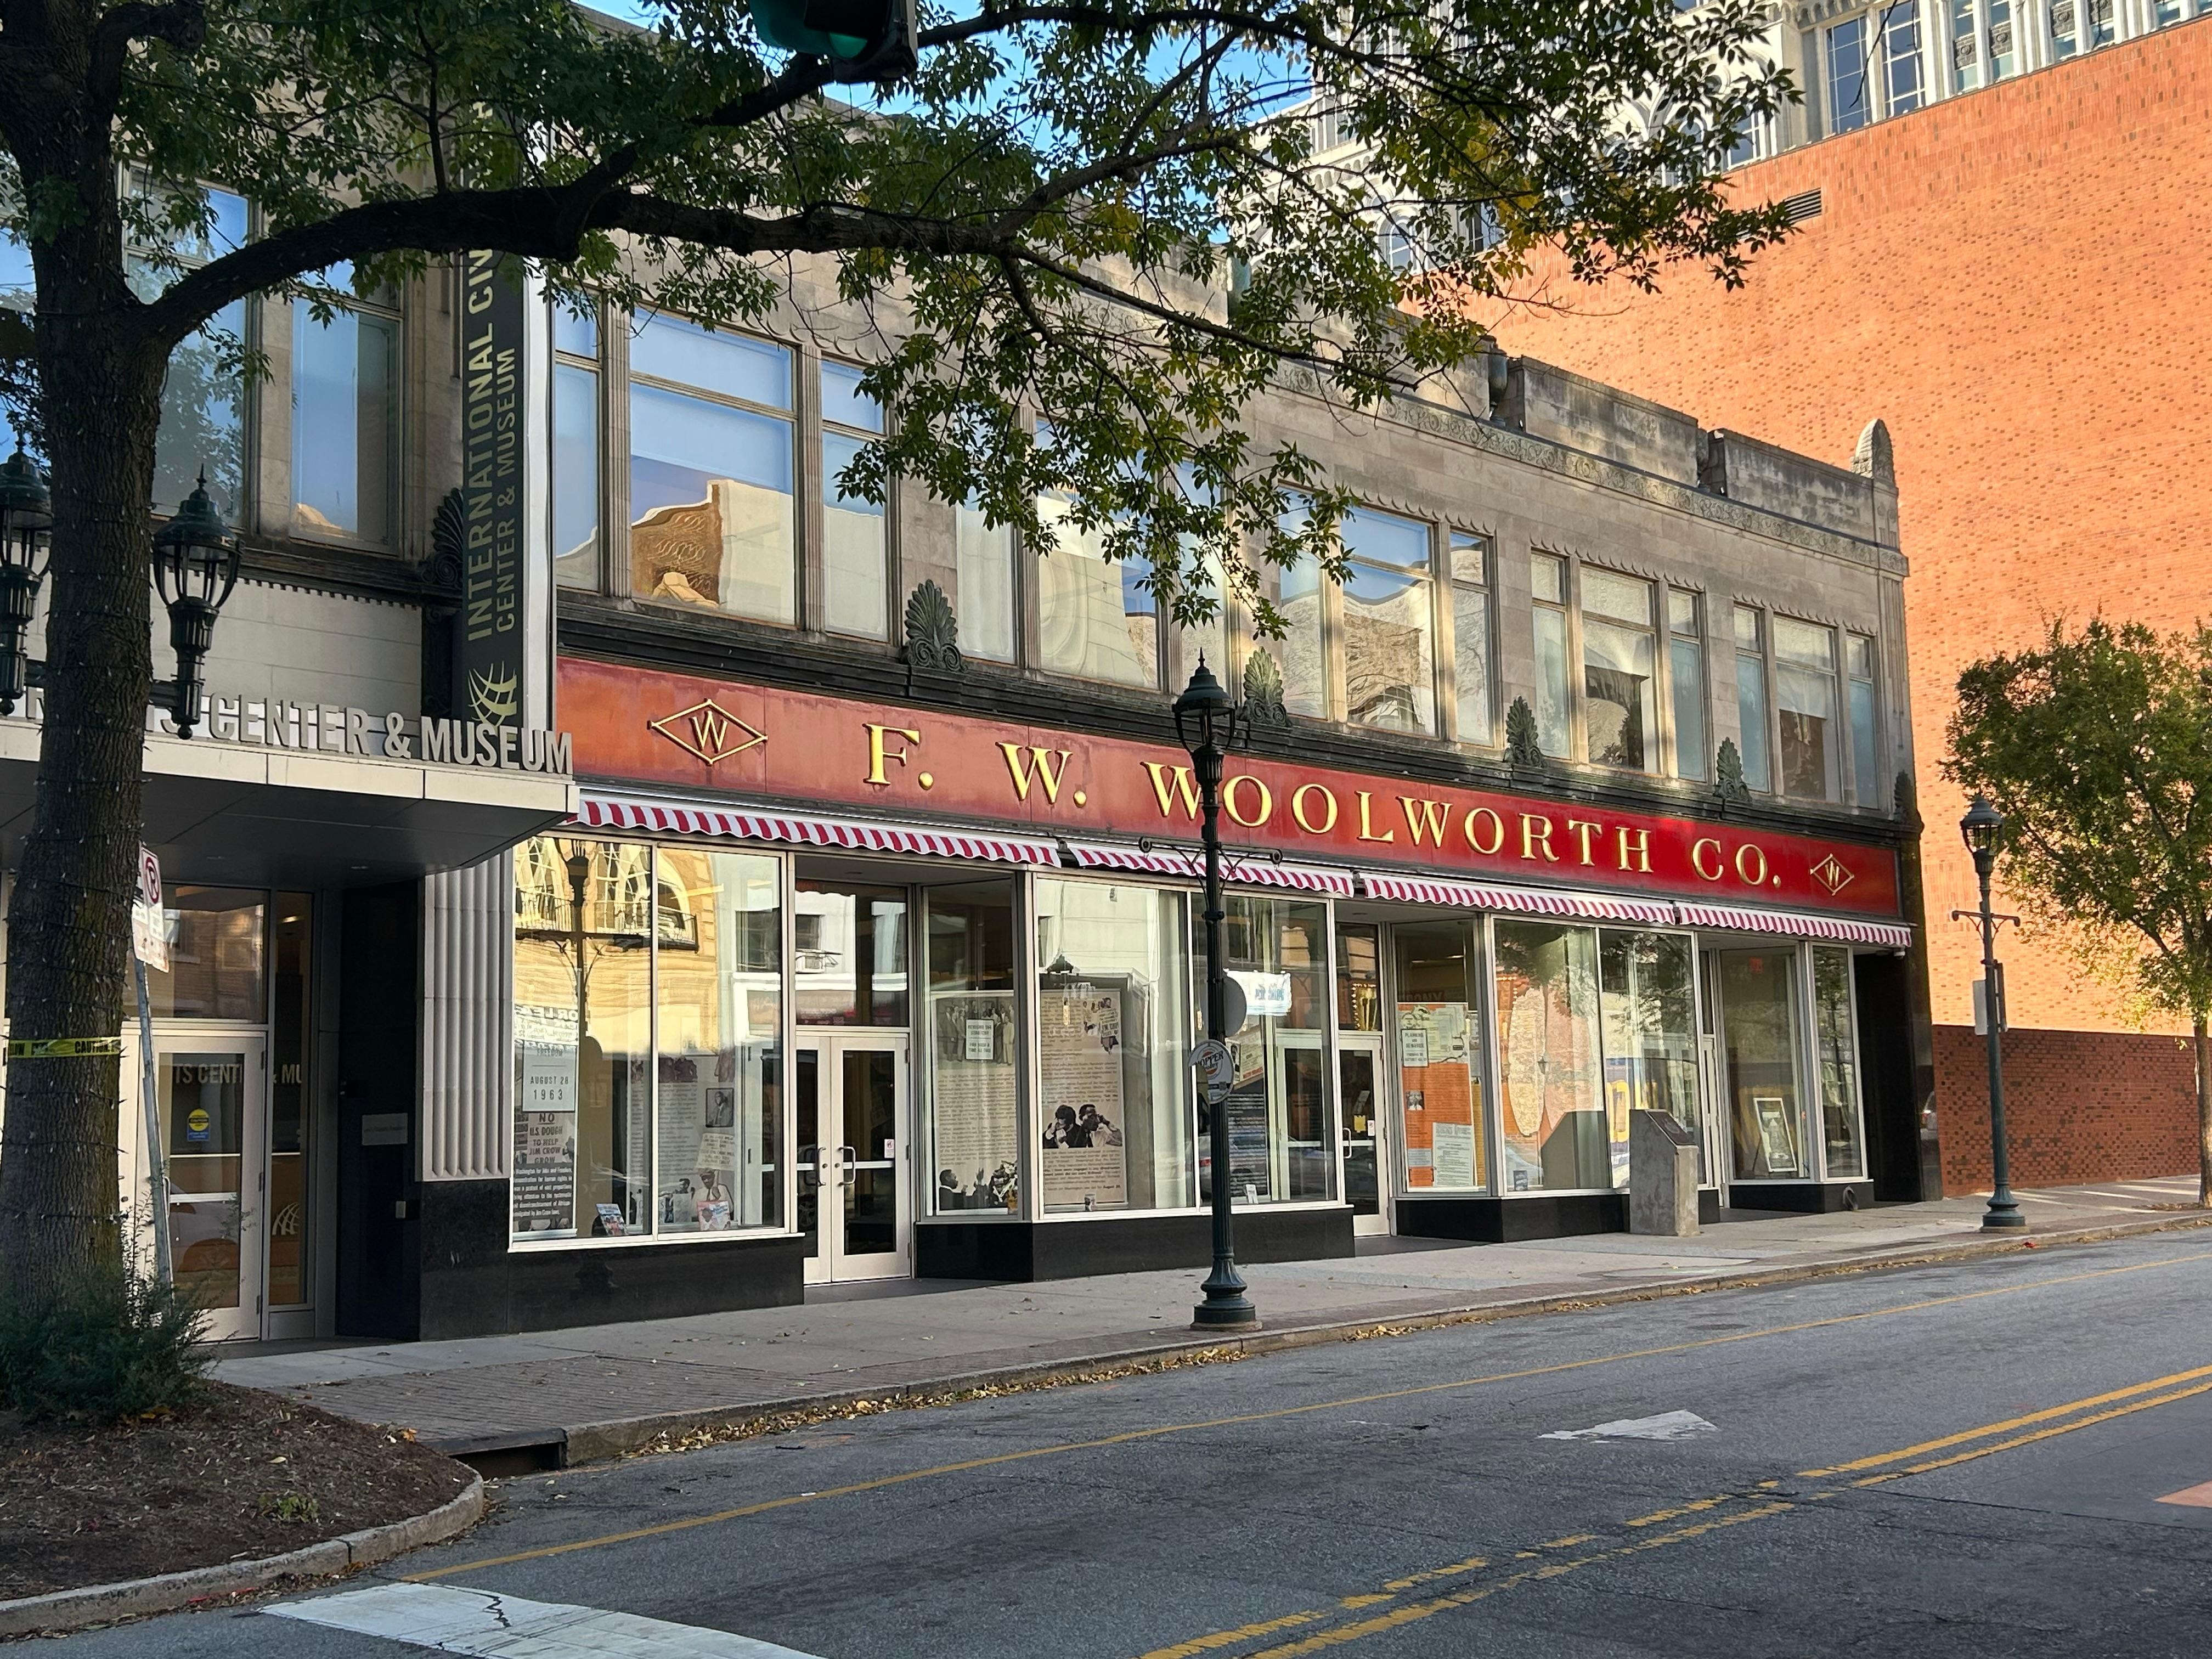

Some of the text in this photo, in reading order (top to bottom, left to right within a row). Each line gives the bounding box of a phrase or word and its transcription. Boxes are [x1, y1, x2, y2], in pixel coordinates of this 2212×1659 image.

[469, 249, 493, 641] INTERNATIONAL CIV
[496, 348, 516, 632] CENTER & MUSEUM
[210, 692, 370, 756] CENTER
[384, 712, 411, 759] &
[421, 716, 573, 775] MUSEUM
[689, 710, 729, 752] W
[862, 723, 1781, 888] F. W. WOOLWORTH CO.
[1195, 1050, 1224, 1066] OPPER
[530, 1076, 568, 1085] AUGUST 28
[534, 1088, 563, 1101] 1963
[539, 1113, 555, 1122] NO
[541, 1126, 563, 1136] DOUGH
[543, 1147, 561, 1155] CROW
